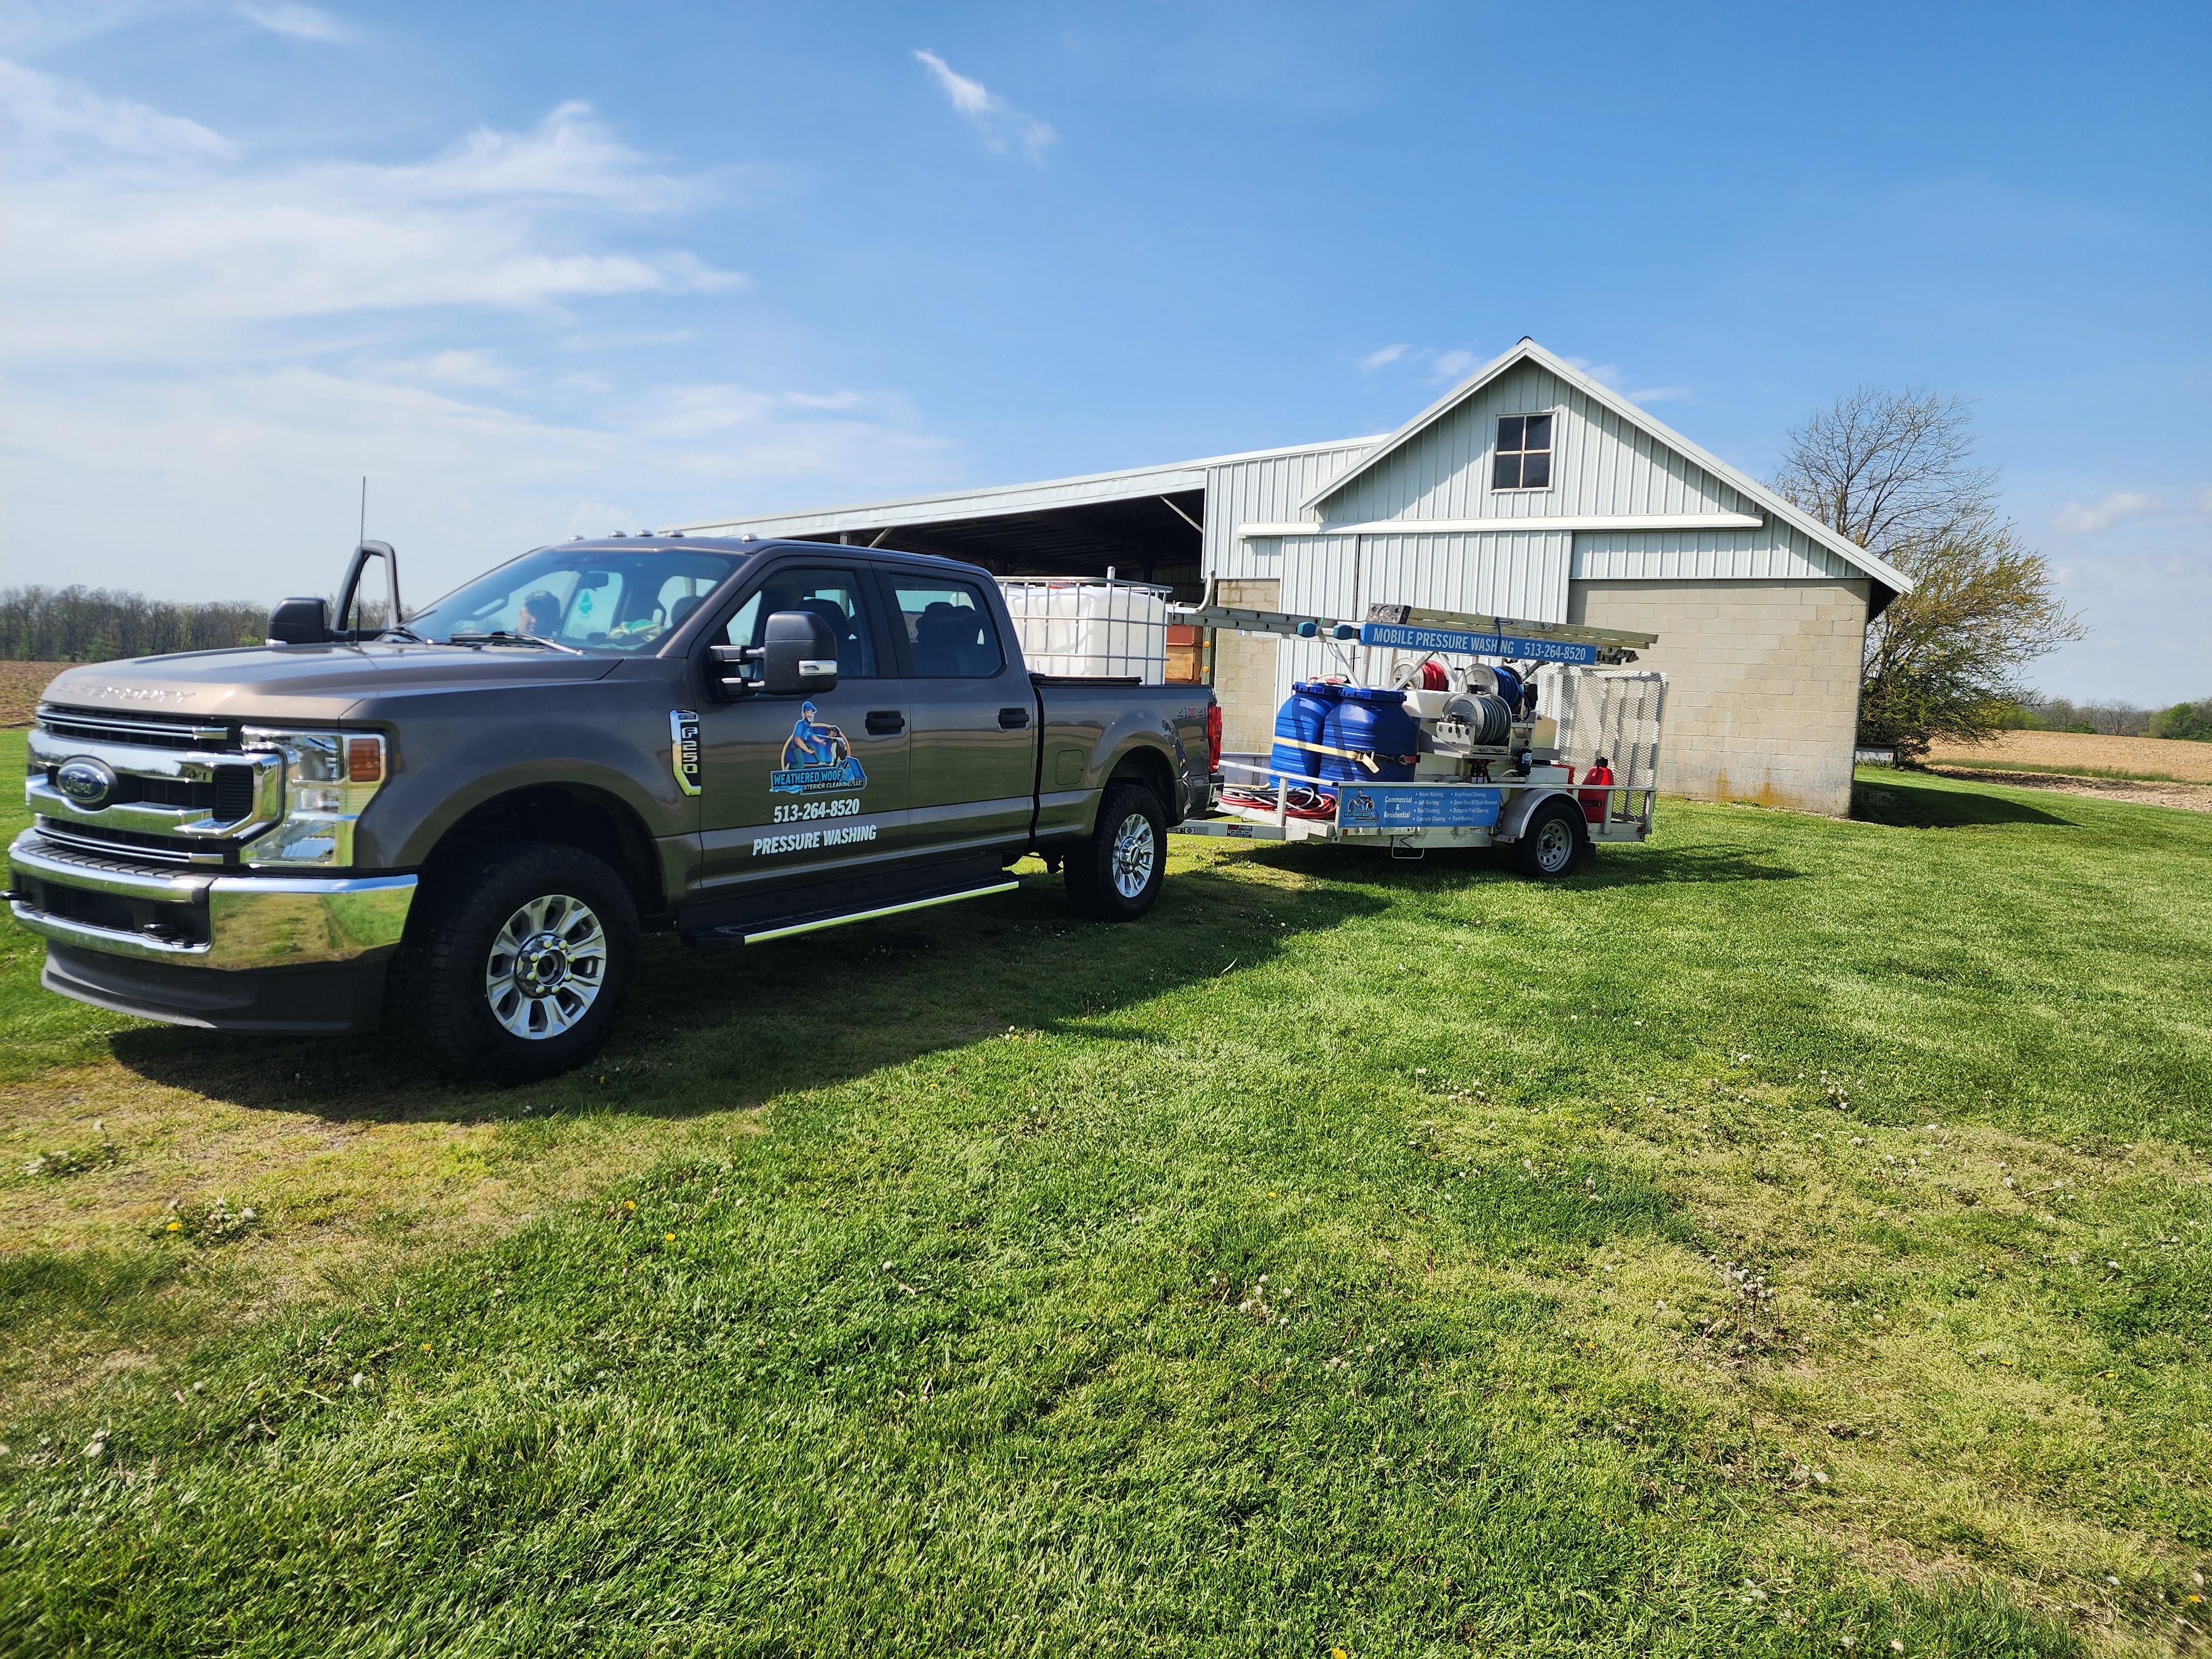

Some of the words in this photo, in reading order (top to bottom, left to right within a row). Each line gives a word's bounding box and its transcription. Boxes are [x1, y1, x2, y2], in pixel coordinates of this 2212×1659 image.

[1373, 627, 1414, 645] MOBILE
[1415, 632, 1468, 650] PRESSURE
[1471, 637, 1514, 654] WASHNG
[1524, 642, 1586, 661] 513-264-8520
[681, 727, 698, 774] F250
[774, 771, 820, 785] WEATHERED
[821, 770, 843, 781] WOOF
[774, 798, 860, 823] 513-264-8520
[752, 831, 821, 856] PRESSURE
[823, 824, 877, 847] WASHING
